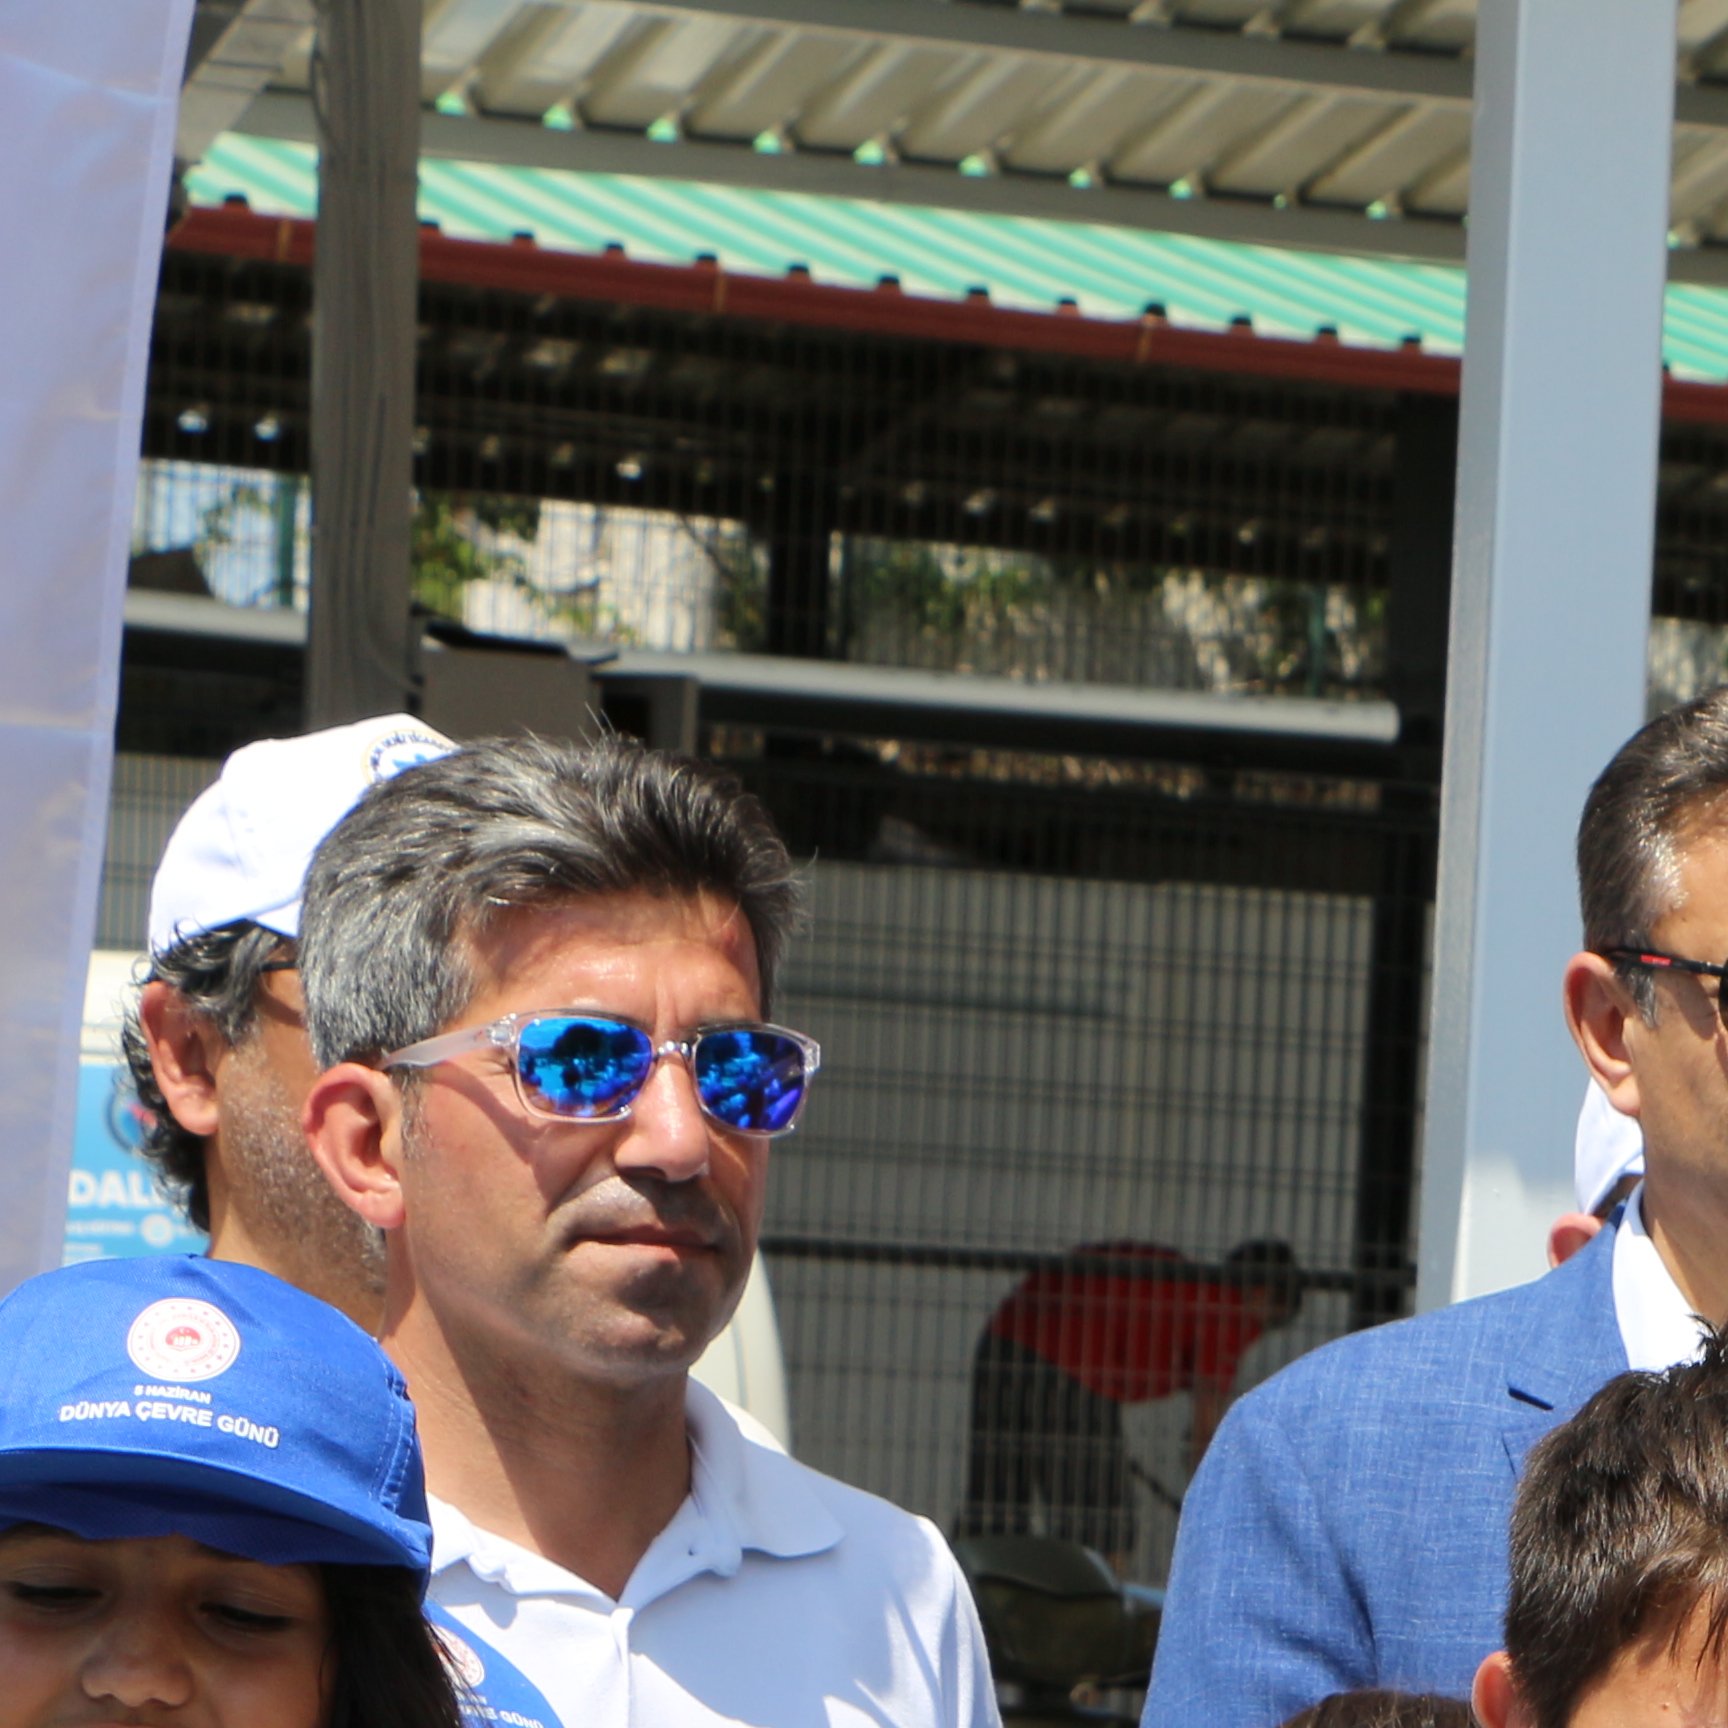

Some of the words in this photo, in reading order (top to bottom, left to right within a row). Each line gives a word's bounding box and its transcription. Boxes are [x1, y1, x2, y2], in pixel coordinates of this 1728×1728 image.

[134, 1384, 144, 1397] 5
[146, 1385, 212, 1405] HAZİRAN
[59, 1401, 131, 1422] DÜNYA
[135, 1401, 214, 1427] ÇEVRE
[217, 1414, 280, 1449] GÜNÜ
